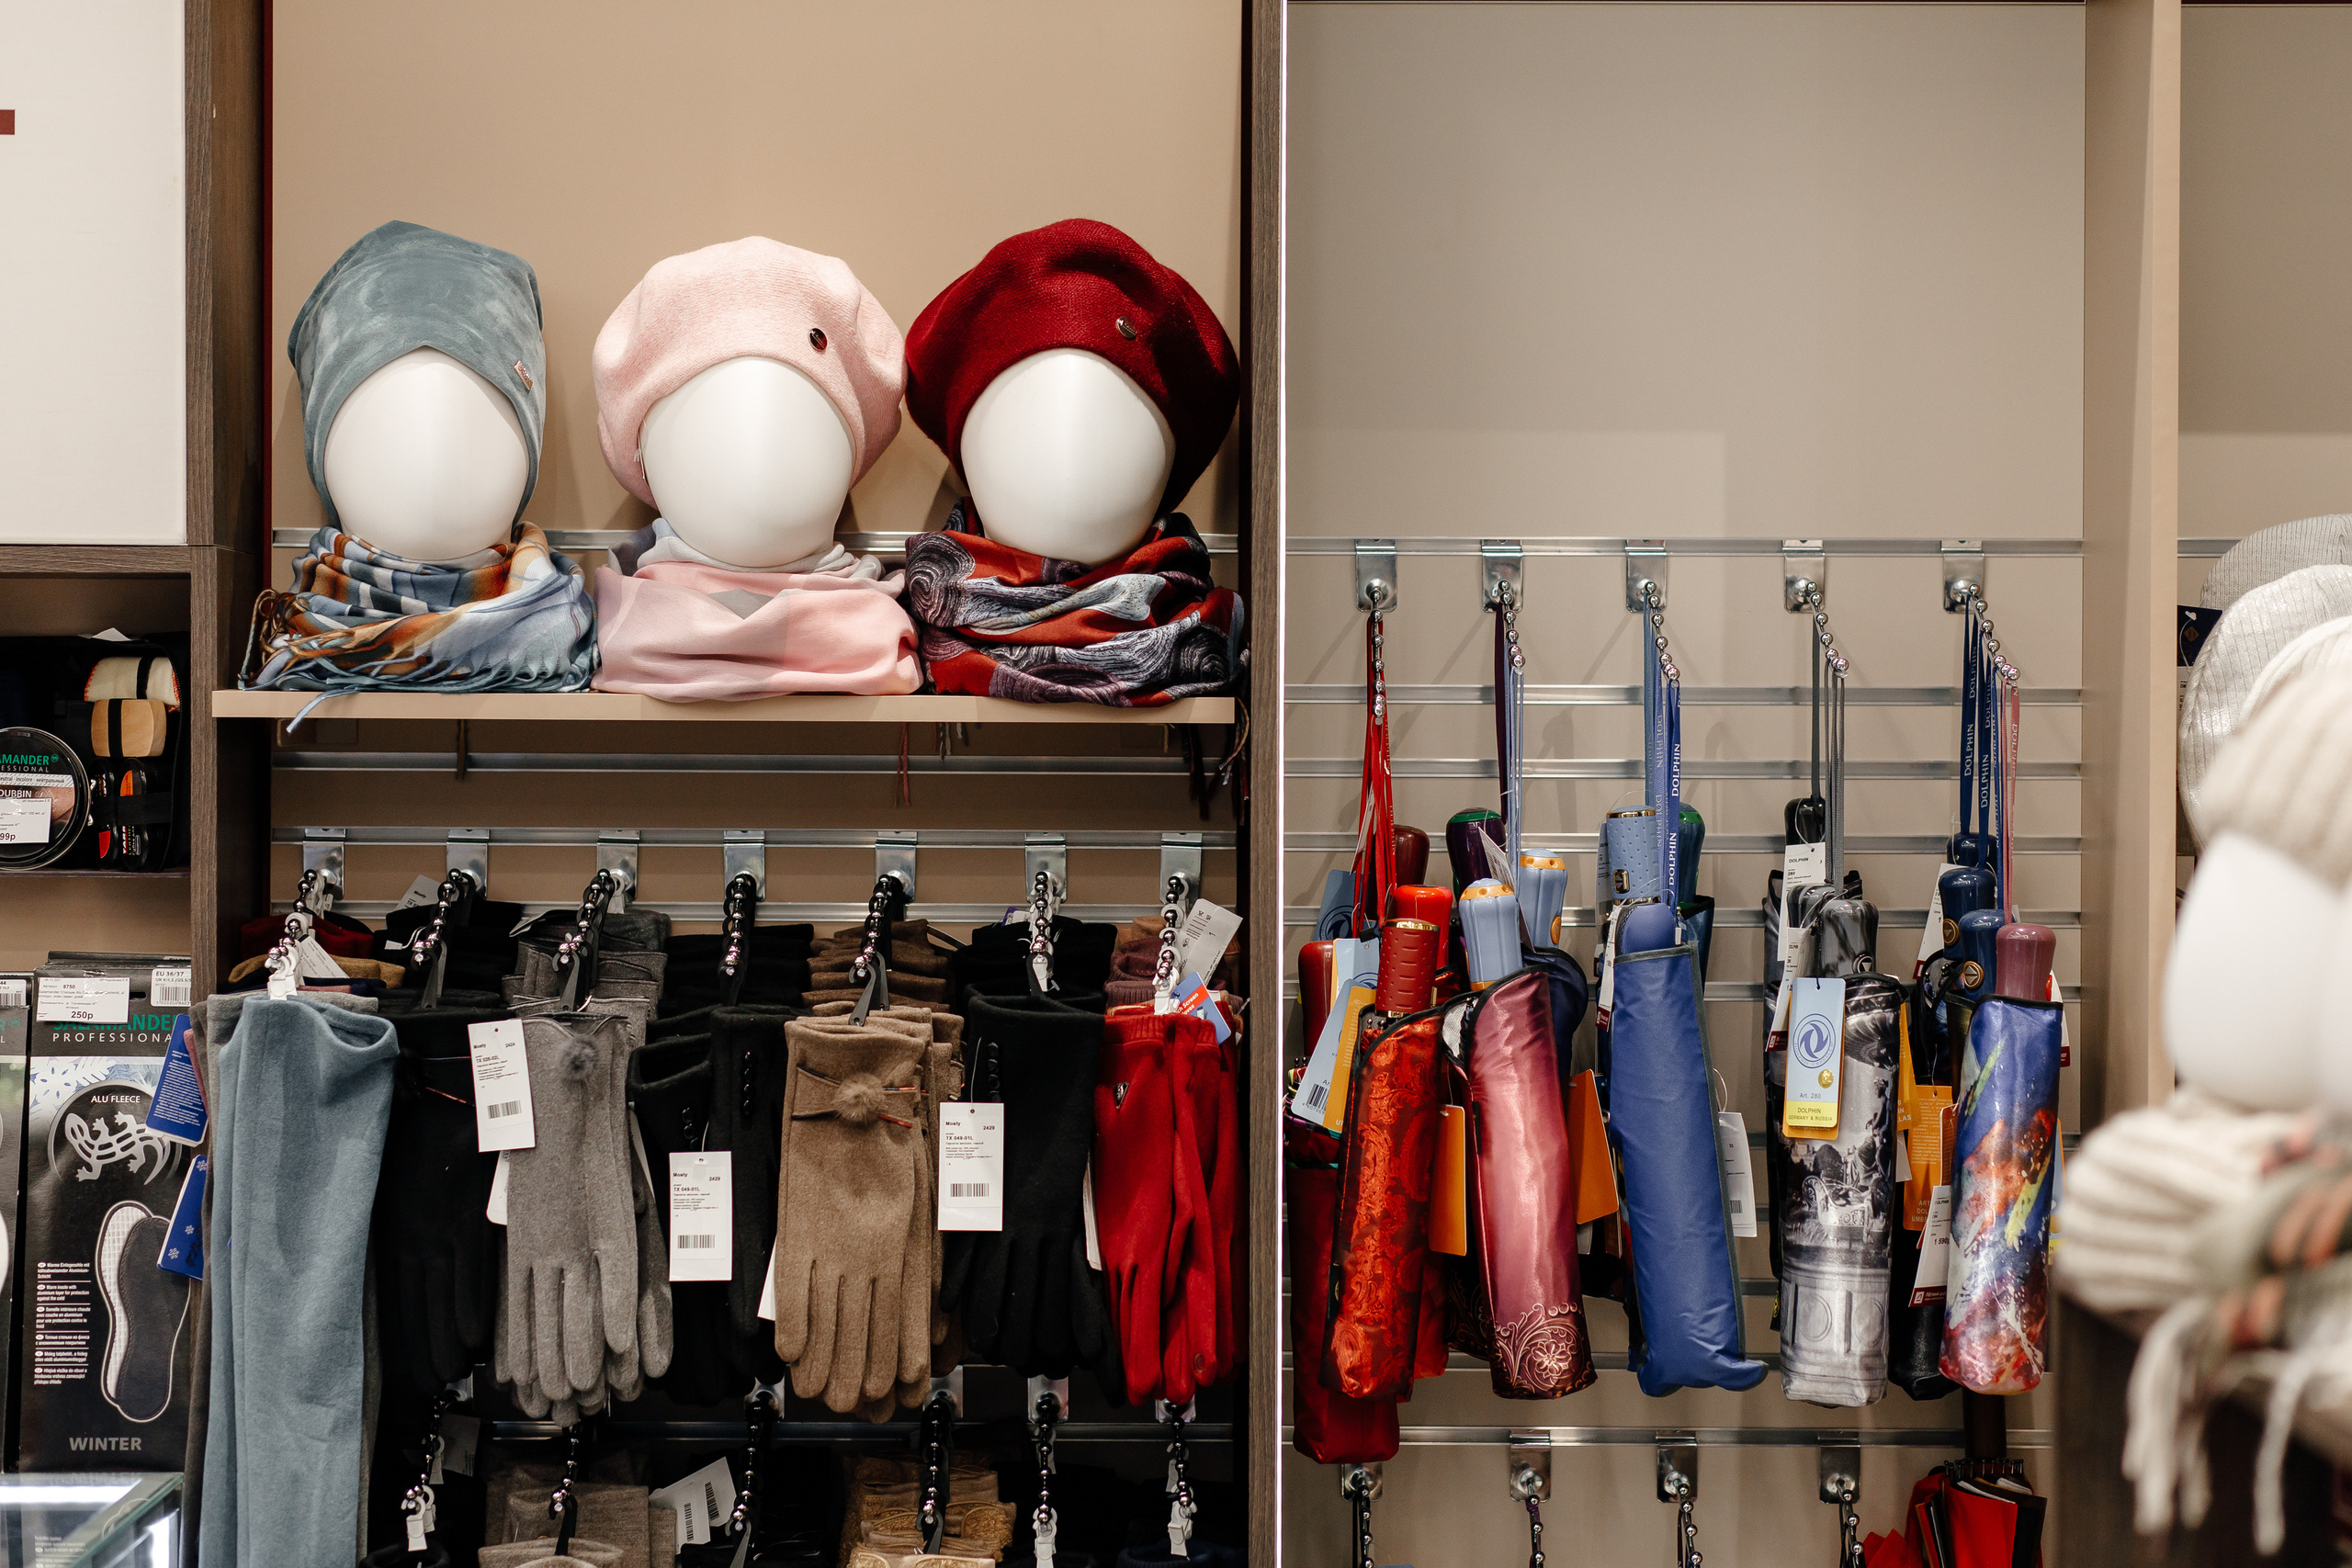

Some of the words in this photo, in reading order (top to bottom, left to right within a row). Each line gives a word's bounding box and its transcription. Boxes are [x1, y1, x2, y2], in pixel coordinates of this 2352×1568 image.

[1964, 723, 1974, 777] DOLPHIN
[0, 754, 50, 765] MANDER
[1671, 743, 1680, 797] DOLPHIN
[1981, 754, 1989, 808] DOLPHIN
[1668, 832, 1677, 886] DOLPHIN
[1182, 992, 1200, 1009] Screen
[52, 1032, 171, 1043] PROFESSIONA
[111, 1095, 141, 1103] FLEECE
[69, 1437, 142, 1451] WINTER
